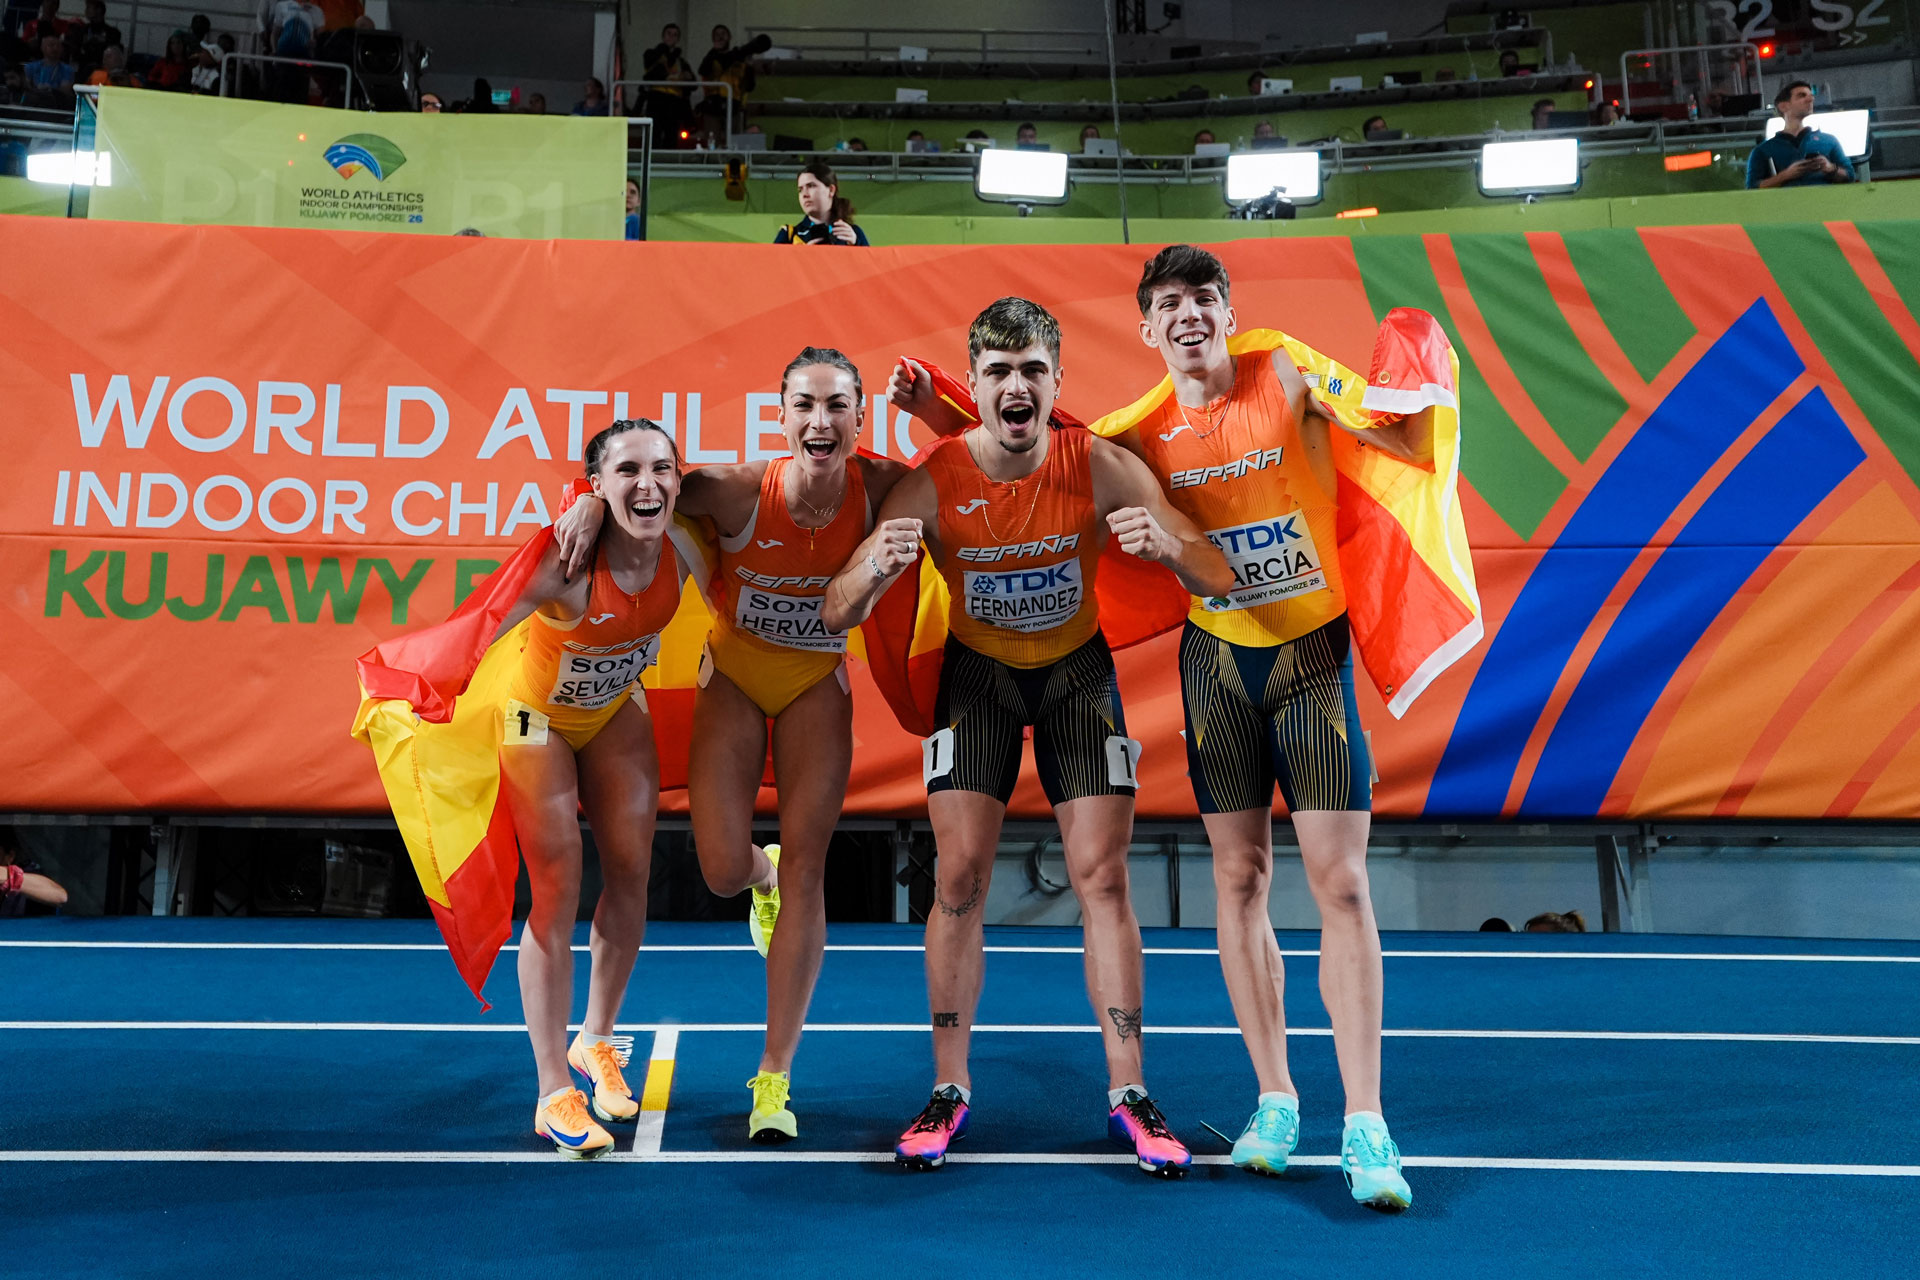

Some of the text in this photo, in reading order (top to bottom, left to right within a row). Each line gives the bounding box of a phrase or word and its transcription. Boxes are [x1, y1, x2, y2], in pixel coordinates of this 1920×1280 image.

[300, 199, 423, 213] INDOOR CHAMPIONSHIPS
[301, 187, 424, 203] WORLD ATHLETICS
[300, 210, 424, 223] KUJAWY POMORZE 26
[70, 373, 450, 458] WORLD
[1170, 446, 1283, 490] ESPAÑA
[52, 470, 368, 534] INDOOR
[956, 533, 1080, 562] ESPAÑA
[1220, 515, 1303, 554] TDK
[995, 562, 1073, 594] TDK
[1229, 549, 1313, 586] ARCÍA
[43, 549, 435, 625] KUJAWY
[971, 586, 1078, 617] FERNANDEZ
[1235, 577, 1320, 603] KUJAWY POMORZE 26
[749, 594, 825, 614] SON
[742, 614, 842, 636] HERVA
[570, 641, 652, 674] SONY
[559, 662, 647, 697] SEVILLA
[517, 710, 530, 736] 1
[931, 738, 939, 771] 1
[1120, 744, 1133, 779] 1
[934, 1012, 959, 1028] HOPE
